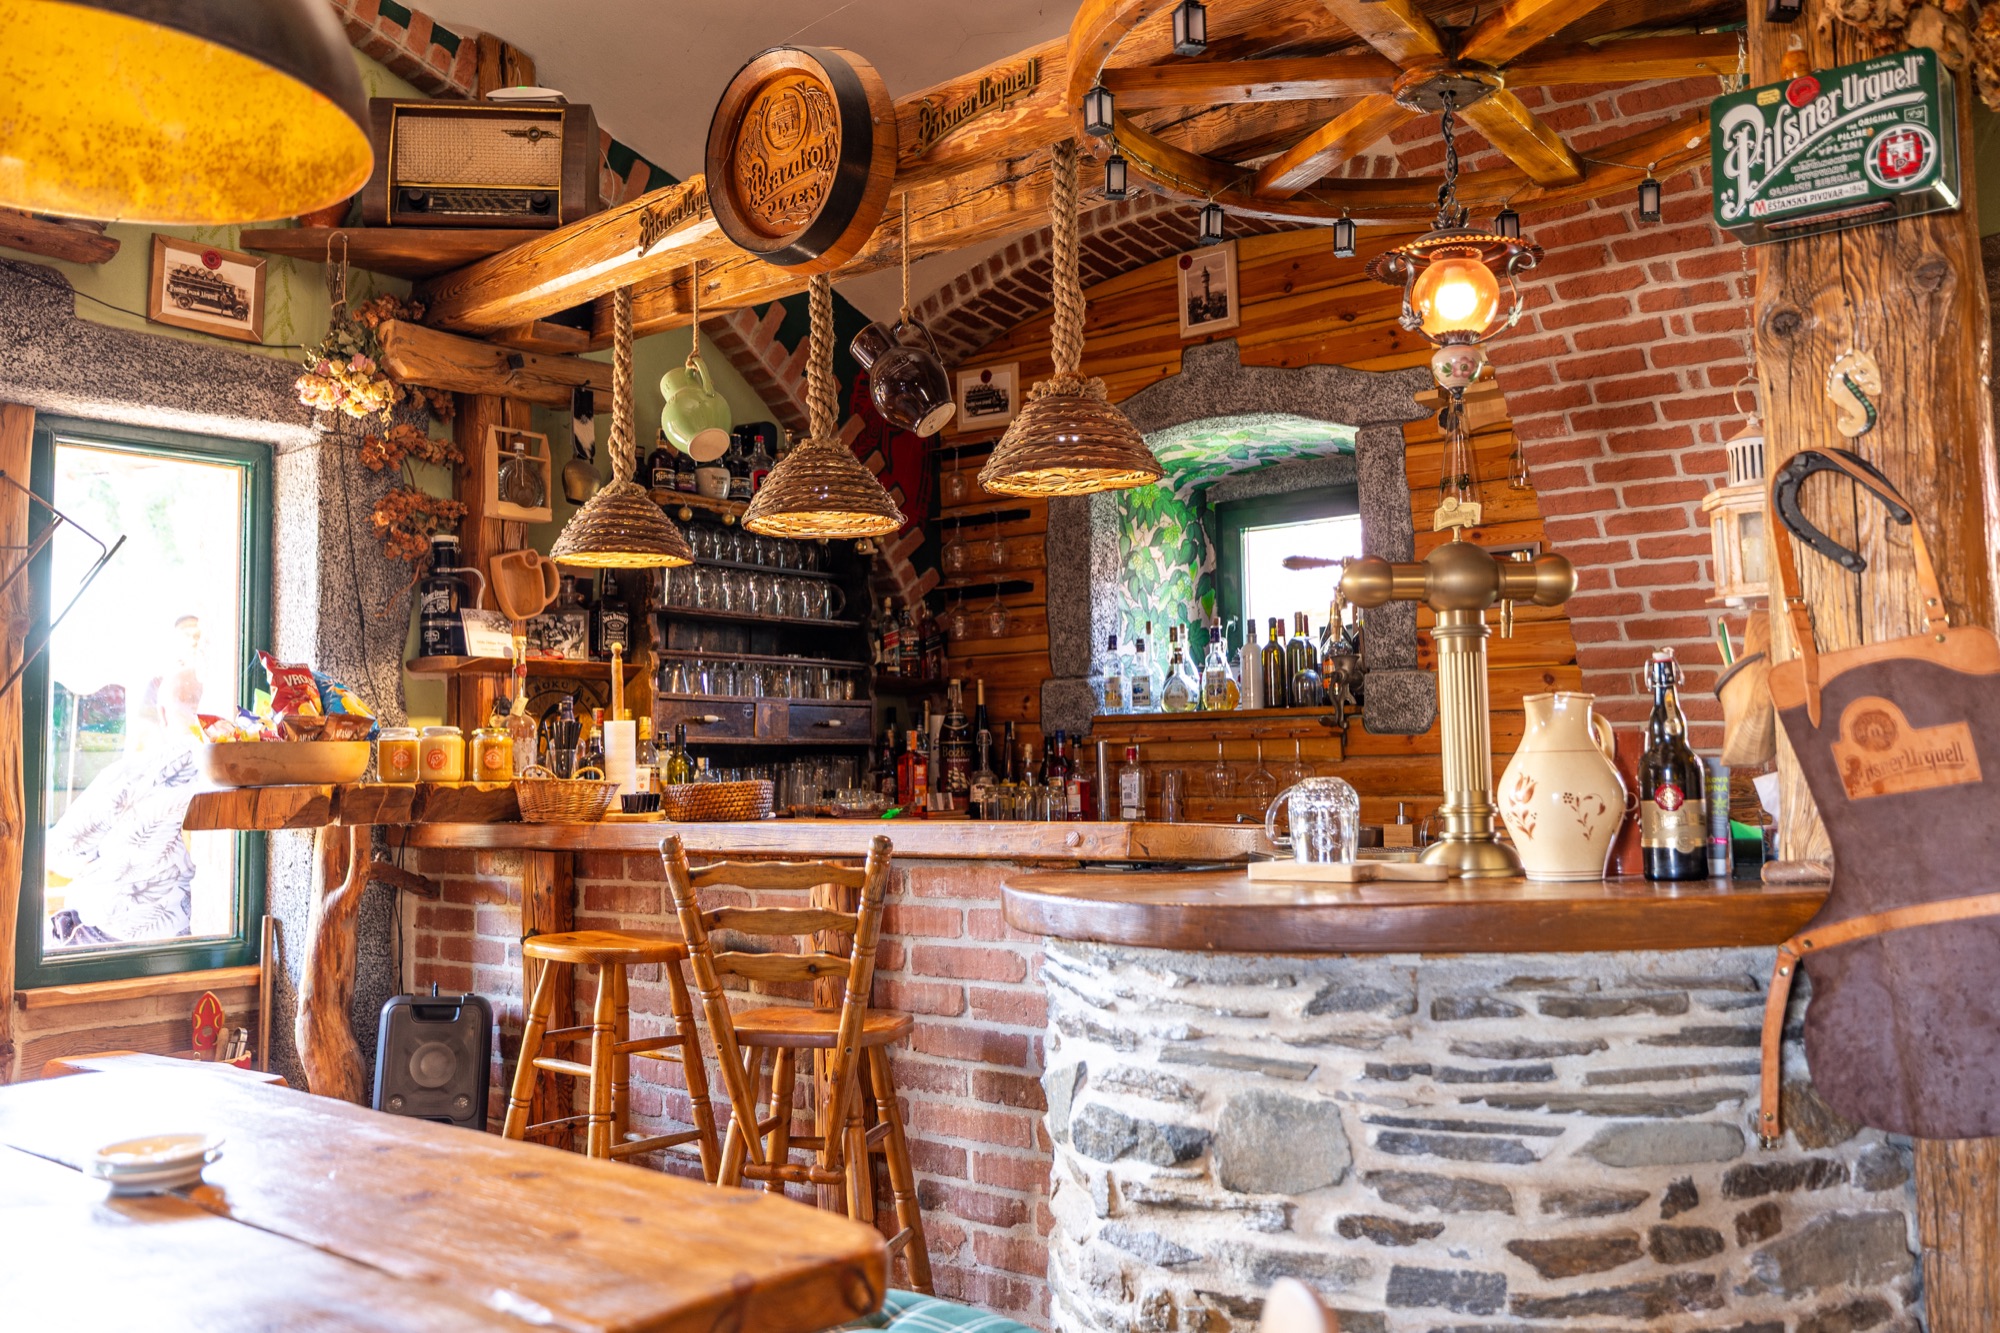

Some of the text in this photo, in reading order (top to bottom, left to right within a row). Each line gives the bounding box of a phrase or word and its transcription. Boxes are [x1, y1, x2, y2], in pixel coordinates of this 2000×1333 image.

[915, 57, 1038, 156] Pilsner Urquell
[1857, 111, 1899, 126] ORIGINAL
[1719, 55, 1919, 221] Pilsner Urquell
[1837, 127, 1874, 142] PILSNE
[751, 144, 829, 208] Prazdroj
[1809, 189, 1844, 204] PIVOVAR
[638, 189, 709, 258] Pilsner Urqu
[942, 745, 972, 758] Božko
[1901, 741, 1965, 774] Urquell
